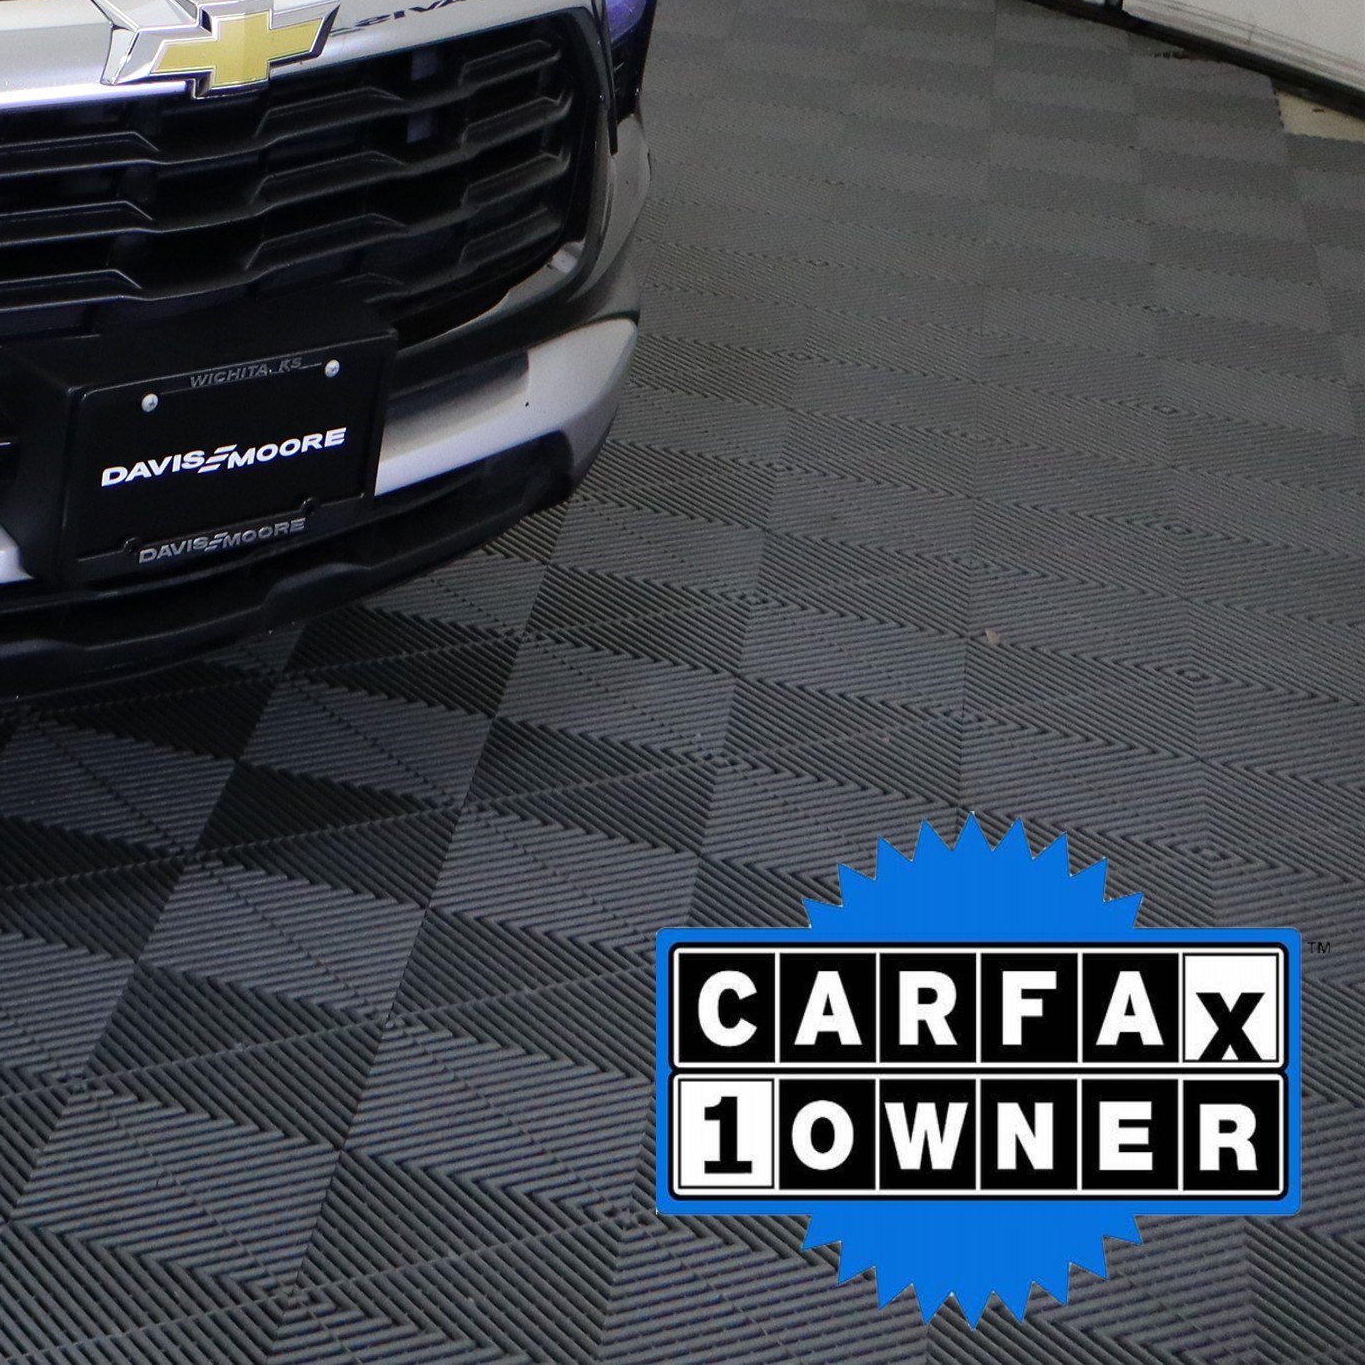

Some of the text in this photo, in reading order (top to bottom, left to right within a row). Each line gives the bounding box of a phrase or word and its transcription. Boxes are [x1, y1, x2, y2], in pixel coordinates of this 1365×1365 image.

[279, 357, 303, 373] KS
[100, 426, 347, 487] DAVIS MOORE
[138, 517, 306, 564] DAVIS MOORE
